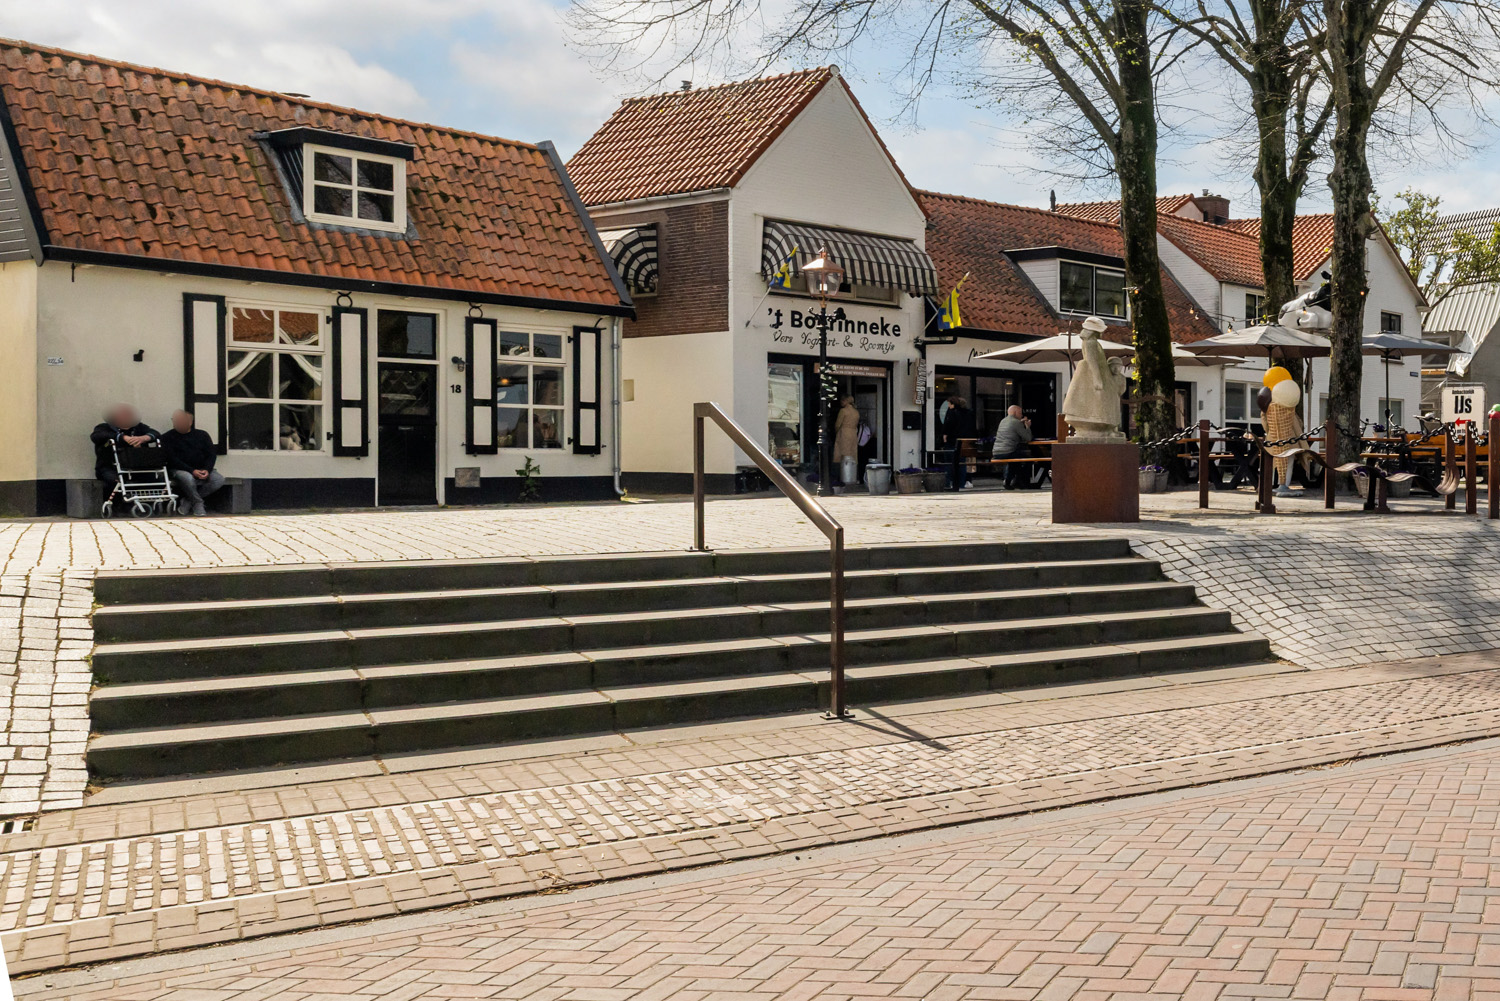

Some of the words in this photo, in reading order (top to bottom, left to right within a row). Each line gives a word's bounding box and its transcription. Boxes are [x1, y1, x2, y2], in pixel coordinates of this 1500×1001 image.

[767, 307, 783, 329] 't
[790, 310, 901, 337] Borinneke
[773, 329, 793, 343] Vers
[801, 332, 840, 349] Yogrt-
[843, 335, 854, 348] &
[860, 337, 895, 354] Roomijs
[450, 384, 462, 393] 18
